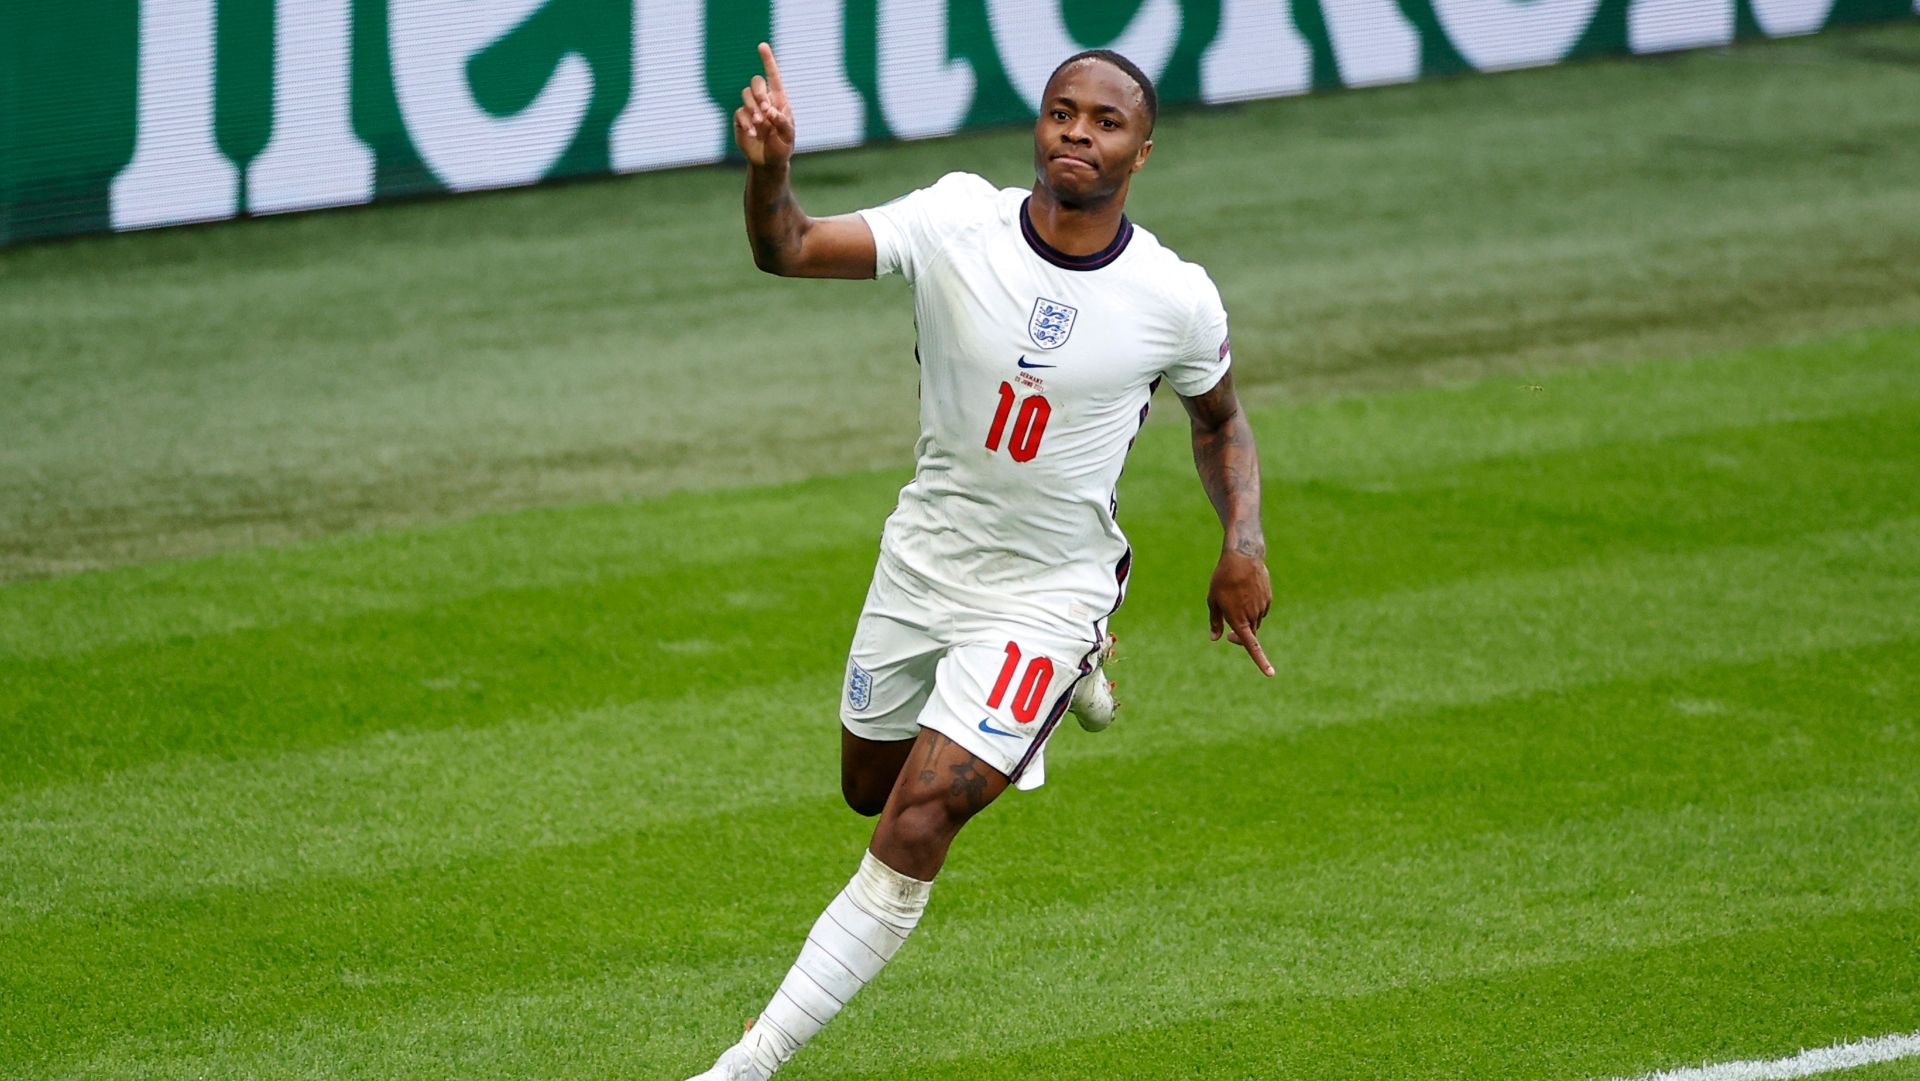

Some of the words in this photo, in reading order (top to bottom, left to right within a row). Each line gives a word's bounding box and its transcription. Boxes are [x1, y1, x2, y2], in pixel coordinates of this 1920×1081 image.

[1020, 371, 1043, 384] GERMANY
[985, 381, 1051, 462] 10
[986, 640, 1054, 723] 10
